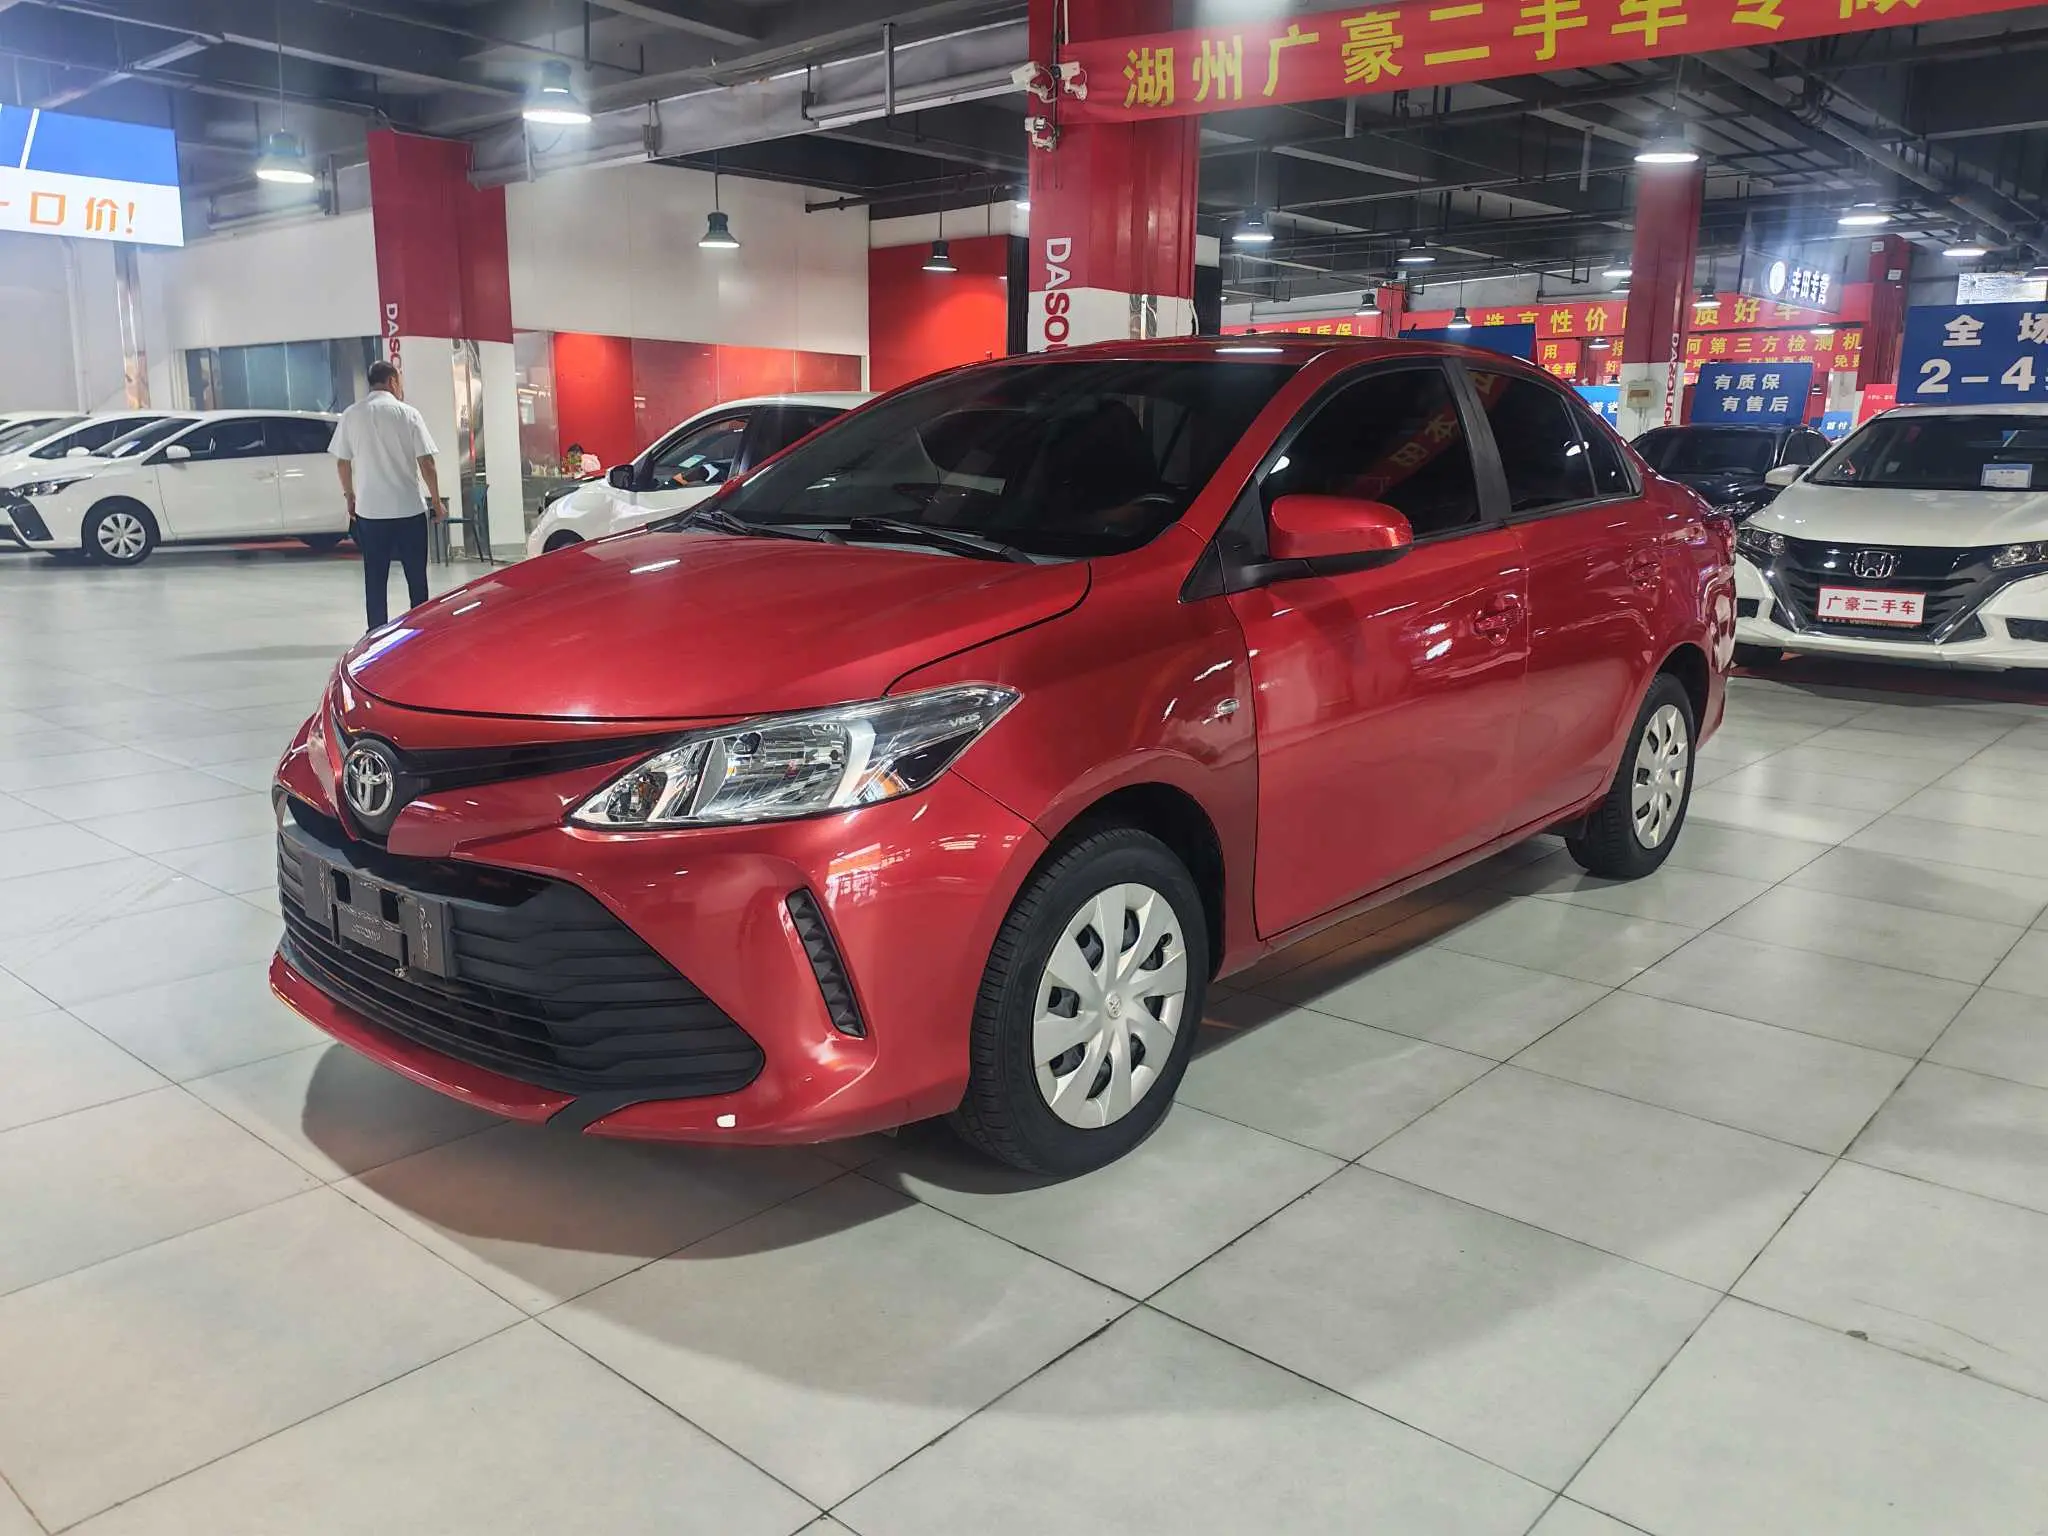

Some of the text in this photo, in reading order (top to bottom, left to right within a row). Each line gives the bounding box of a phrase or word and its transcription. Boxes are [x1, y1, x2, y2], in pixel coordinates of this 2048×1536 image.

[0, 191, 136, 234] 口价!
[1045, 237, 1072, 352] DASO
[1663, 332, 1681, 425] DASOUC
[1714, 373, 1781, 391] 有质保
[1917, 355, 2048, 394] 2-4
[1721, 396, 1789, 412] 有售后
[1826, 596, 1916, 616] 广豪二手车
